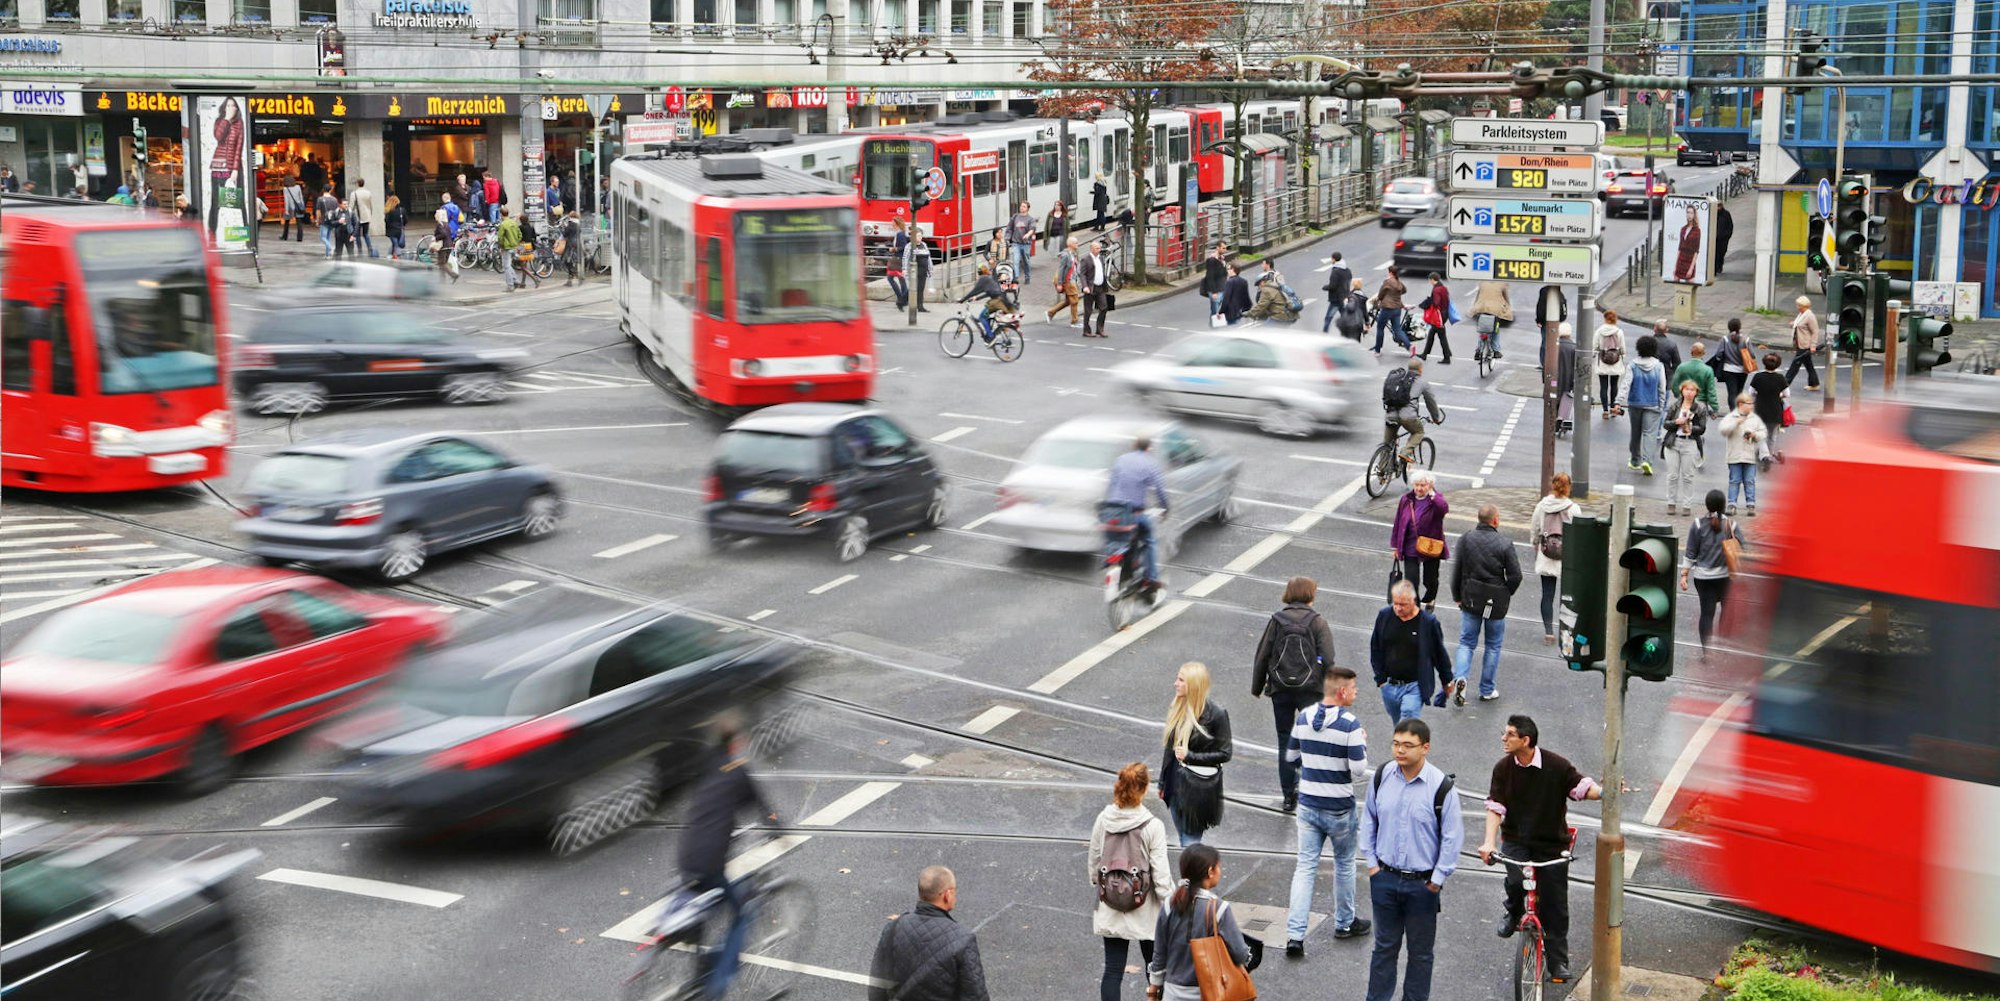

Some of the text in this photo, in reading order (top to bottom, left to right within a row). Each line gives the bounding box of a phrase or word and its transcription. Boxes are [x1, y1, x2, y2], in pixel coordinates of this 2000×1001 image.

[375, 13, 481, 29] heilpraktikerschule
[797, 87, 828, 105] KIOS
[249, 94, 315, 115] rzenich
[427, 95, 506, 115] Merzenich
[547, 106, 555, 118] 3
[1046, 127, 1055, 137] 4
[1482, 124, 1568, 142] Parkleitsystem
[1520, 157, 1569, 168] Dom/Rhein
[1512, 170, 1545, 188] 920
[1551, 178, 1567, 187] freie
[1521, 202, 1563, 214] Neumarkt
[1666, 199, 1709, 211] MANGO
[1500, 216, 1543, 234] 1578
[1550, 225, 1566, 233] freie
[1528, 248, 1553, 259] Ringe
[1497, 262, 1541, 279] 1480
[1548, 271, 1564, 279] freie
